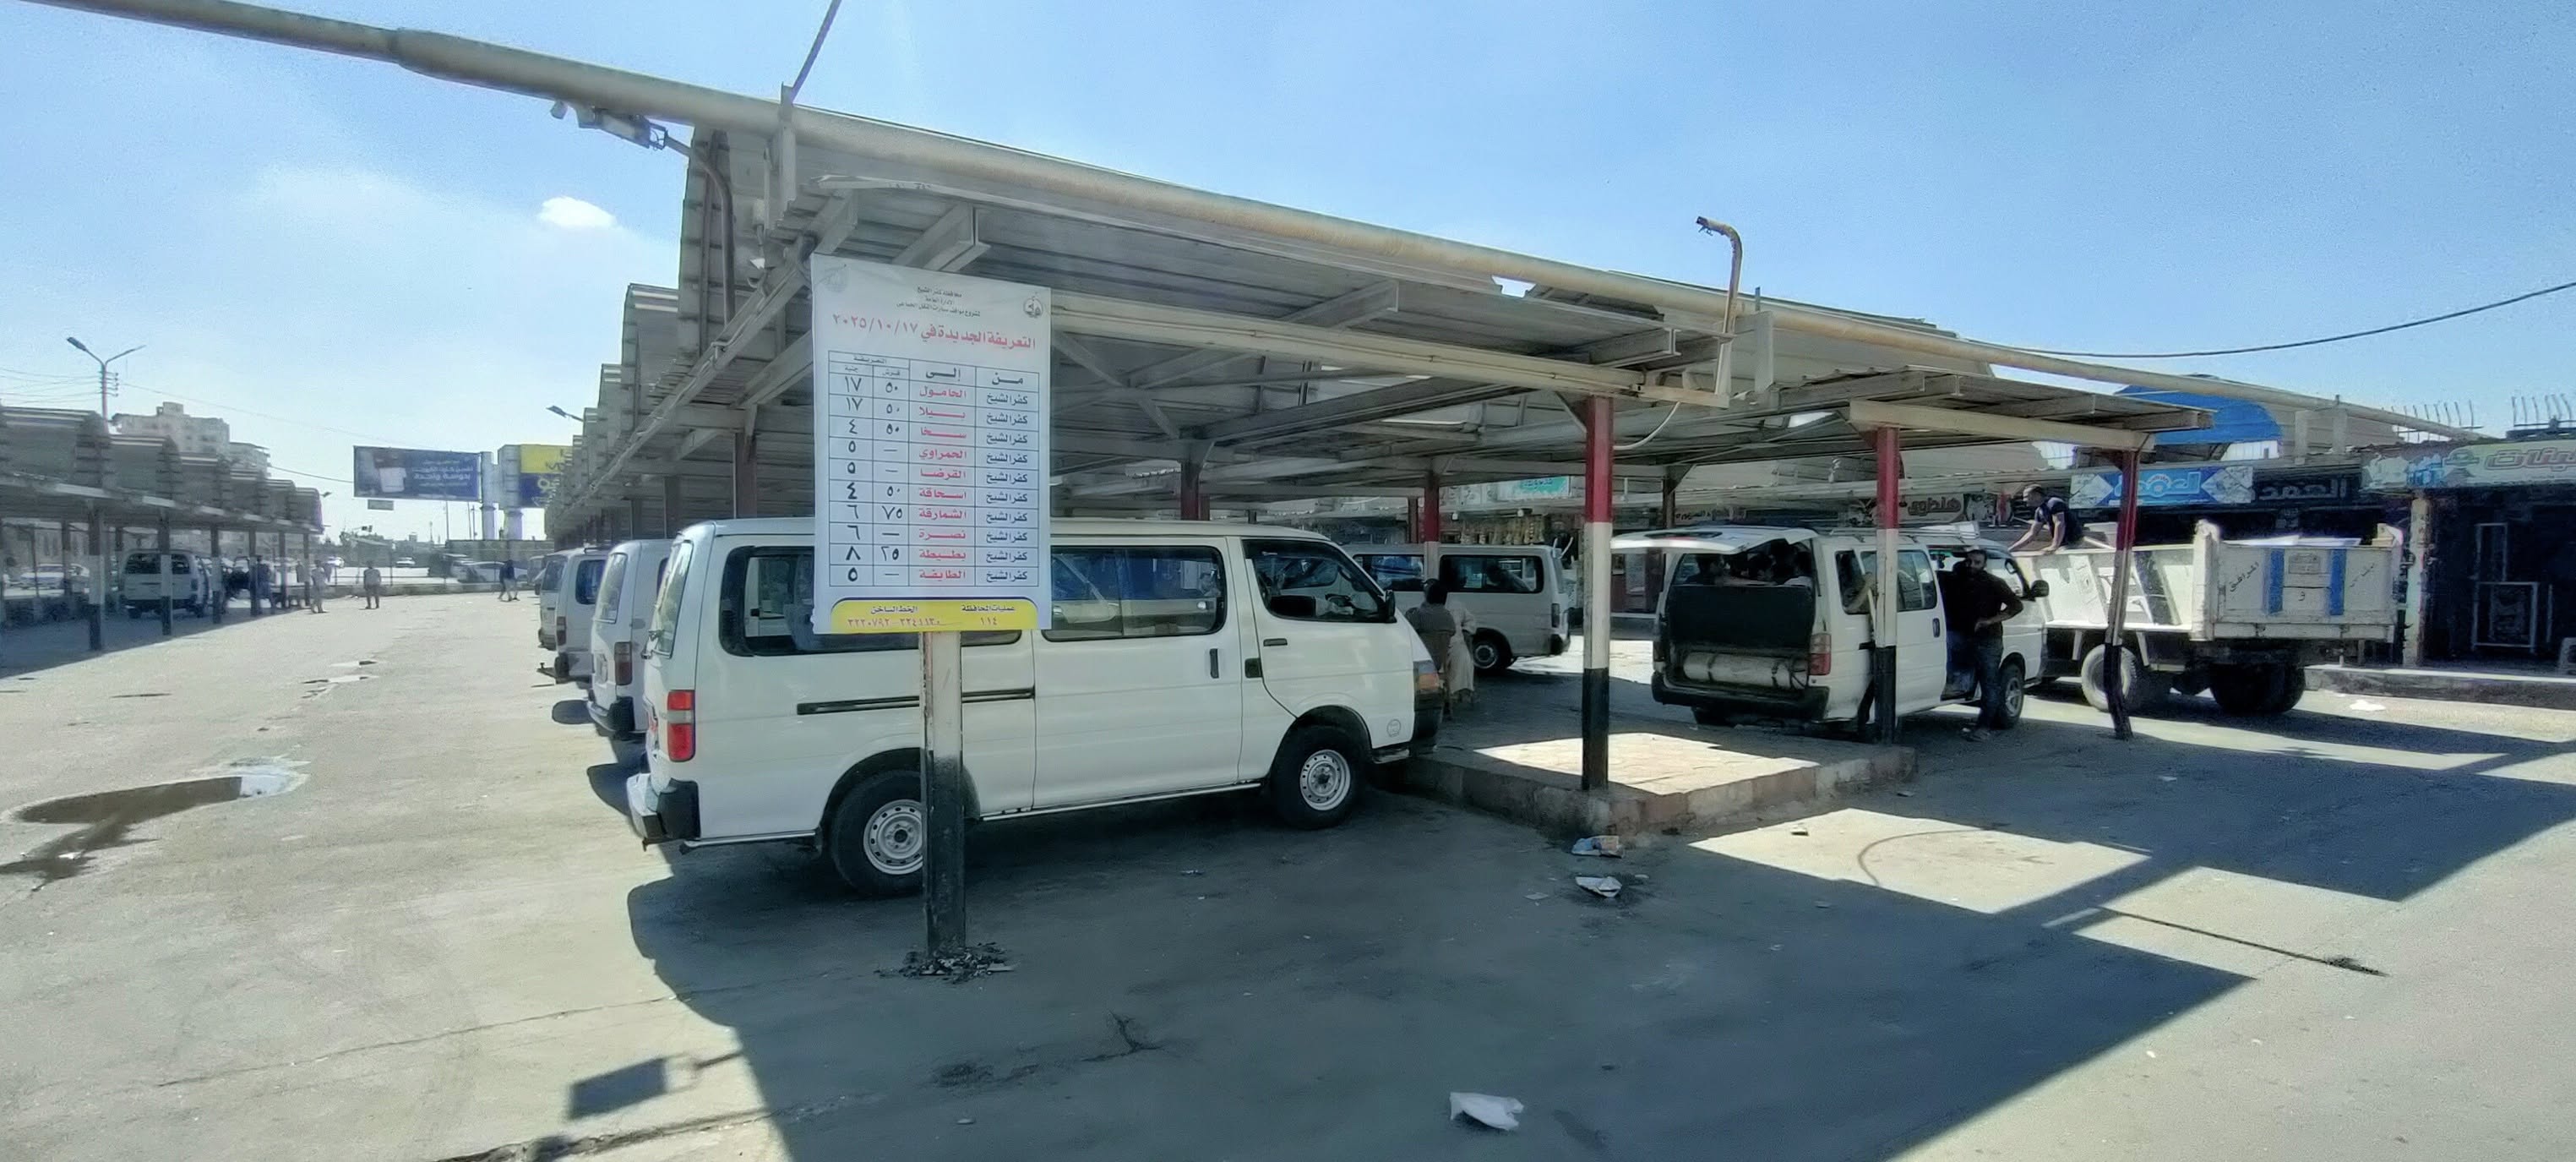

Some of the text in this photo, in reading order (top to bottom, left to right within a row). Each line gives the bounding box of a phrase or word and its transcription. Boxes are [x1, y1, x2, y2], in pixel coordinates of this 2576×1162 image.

[921, 323, 937, 342] في
[939, 325, 987, 346] الجديدة
[988, 332, 1036, 350] التعريفة
[992, 372, 1024, 385] من
[845, 376, 1028, 406] كفر الشيخ الحامول ٥٠ ١٧
[847, 397, 1028, 425] كفر الشيخ بيلا ٥٠ ١٧
[848, 419, 1028, 445] كفر الشيخ سخا ٥٠ ٤
[848, 440, 1028, 465] كفر الشيخ الحمراوي ٥
[847, 461, 1028, 484] كفر الشيخ القرضا ٥
[847, 482, 858, 499] ٤
[887, 486, 901, 497] ٥٠
[986, 492, 1012, 505] الشيخ
[1012, 493, 1028, 505] كفر
[847, 505, 1028, 523] كفر الشيخ الشمارقة ٧٥ ٦
[847, 525, 860, 540] ٦
[986, 530, 1012, 543] الشيخ
[1012, 531, 1028, 543] كفر
[846, 545, 861, 560] ٨
[881, 546, 899, 561] ٢٥
[986, 550, 1012, 563] الشيخ
[1012, 551, 1028, 563] كفر
[847, 567, 858, 581] ٥
[986, 570, 1012, 582] الشيخ
[1012, 570, 1028, 582] كفر
